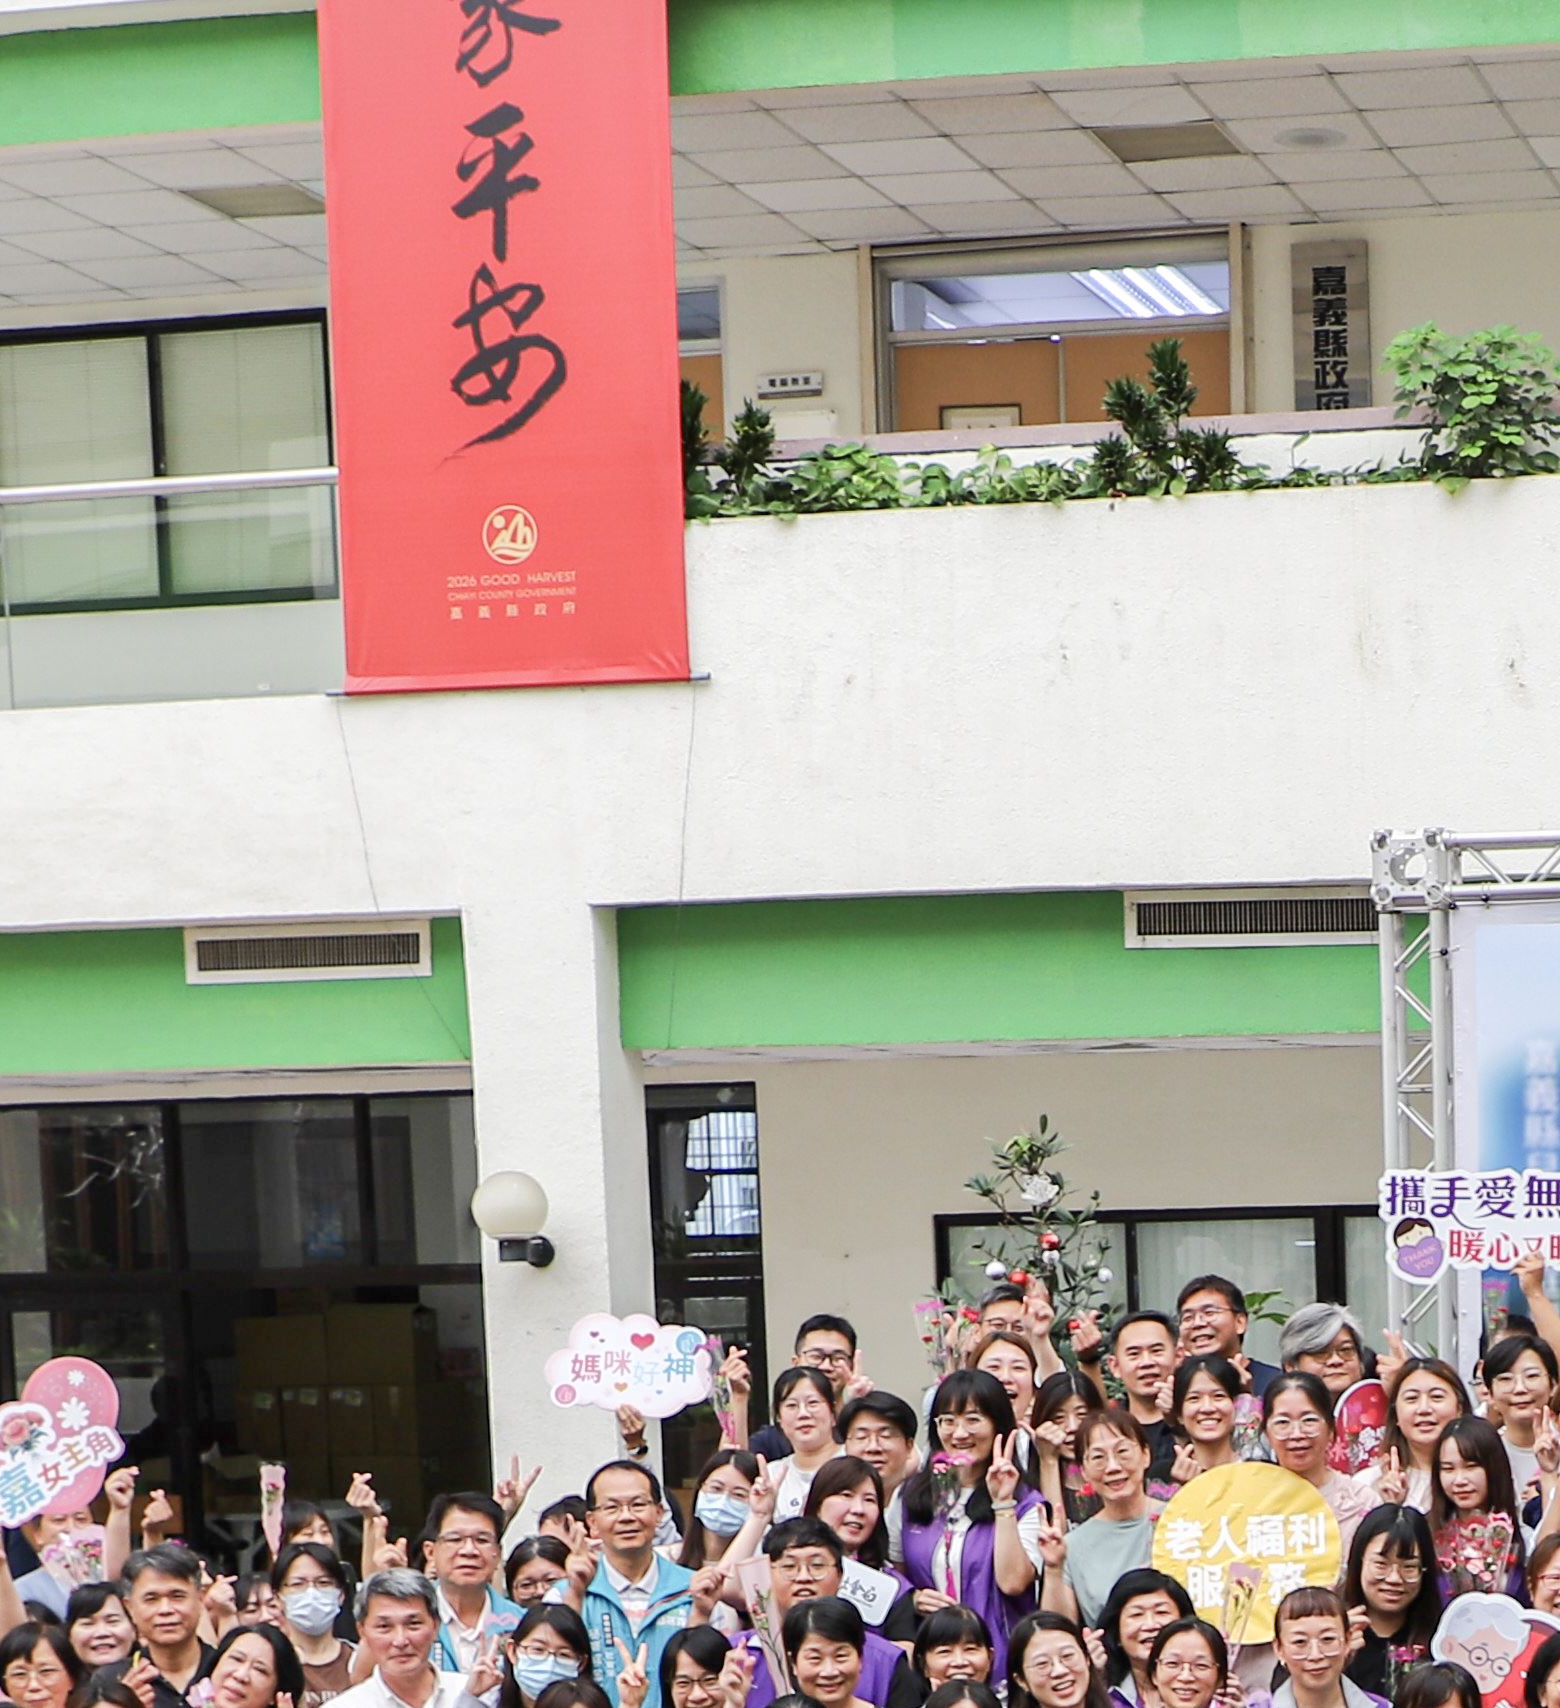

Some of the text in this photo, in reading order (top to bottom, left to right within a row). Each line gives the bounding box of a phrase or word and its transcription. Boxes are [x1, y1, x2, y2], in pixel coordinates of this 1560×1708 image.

[447, 571, 577, 588] 2026 GOOD HARVEST
[1402, 1244, 1439, 1265] THANK
[1413, 1257, 1435, 1271] YOU
[571, 1351, 695, 1386] 媽咪好神
[1165, 1512, 1327, 1560] 老人福利
